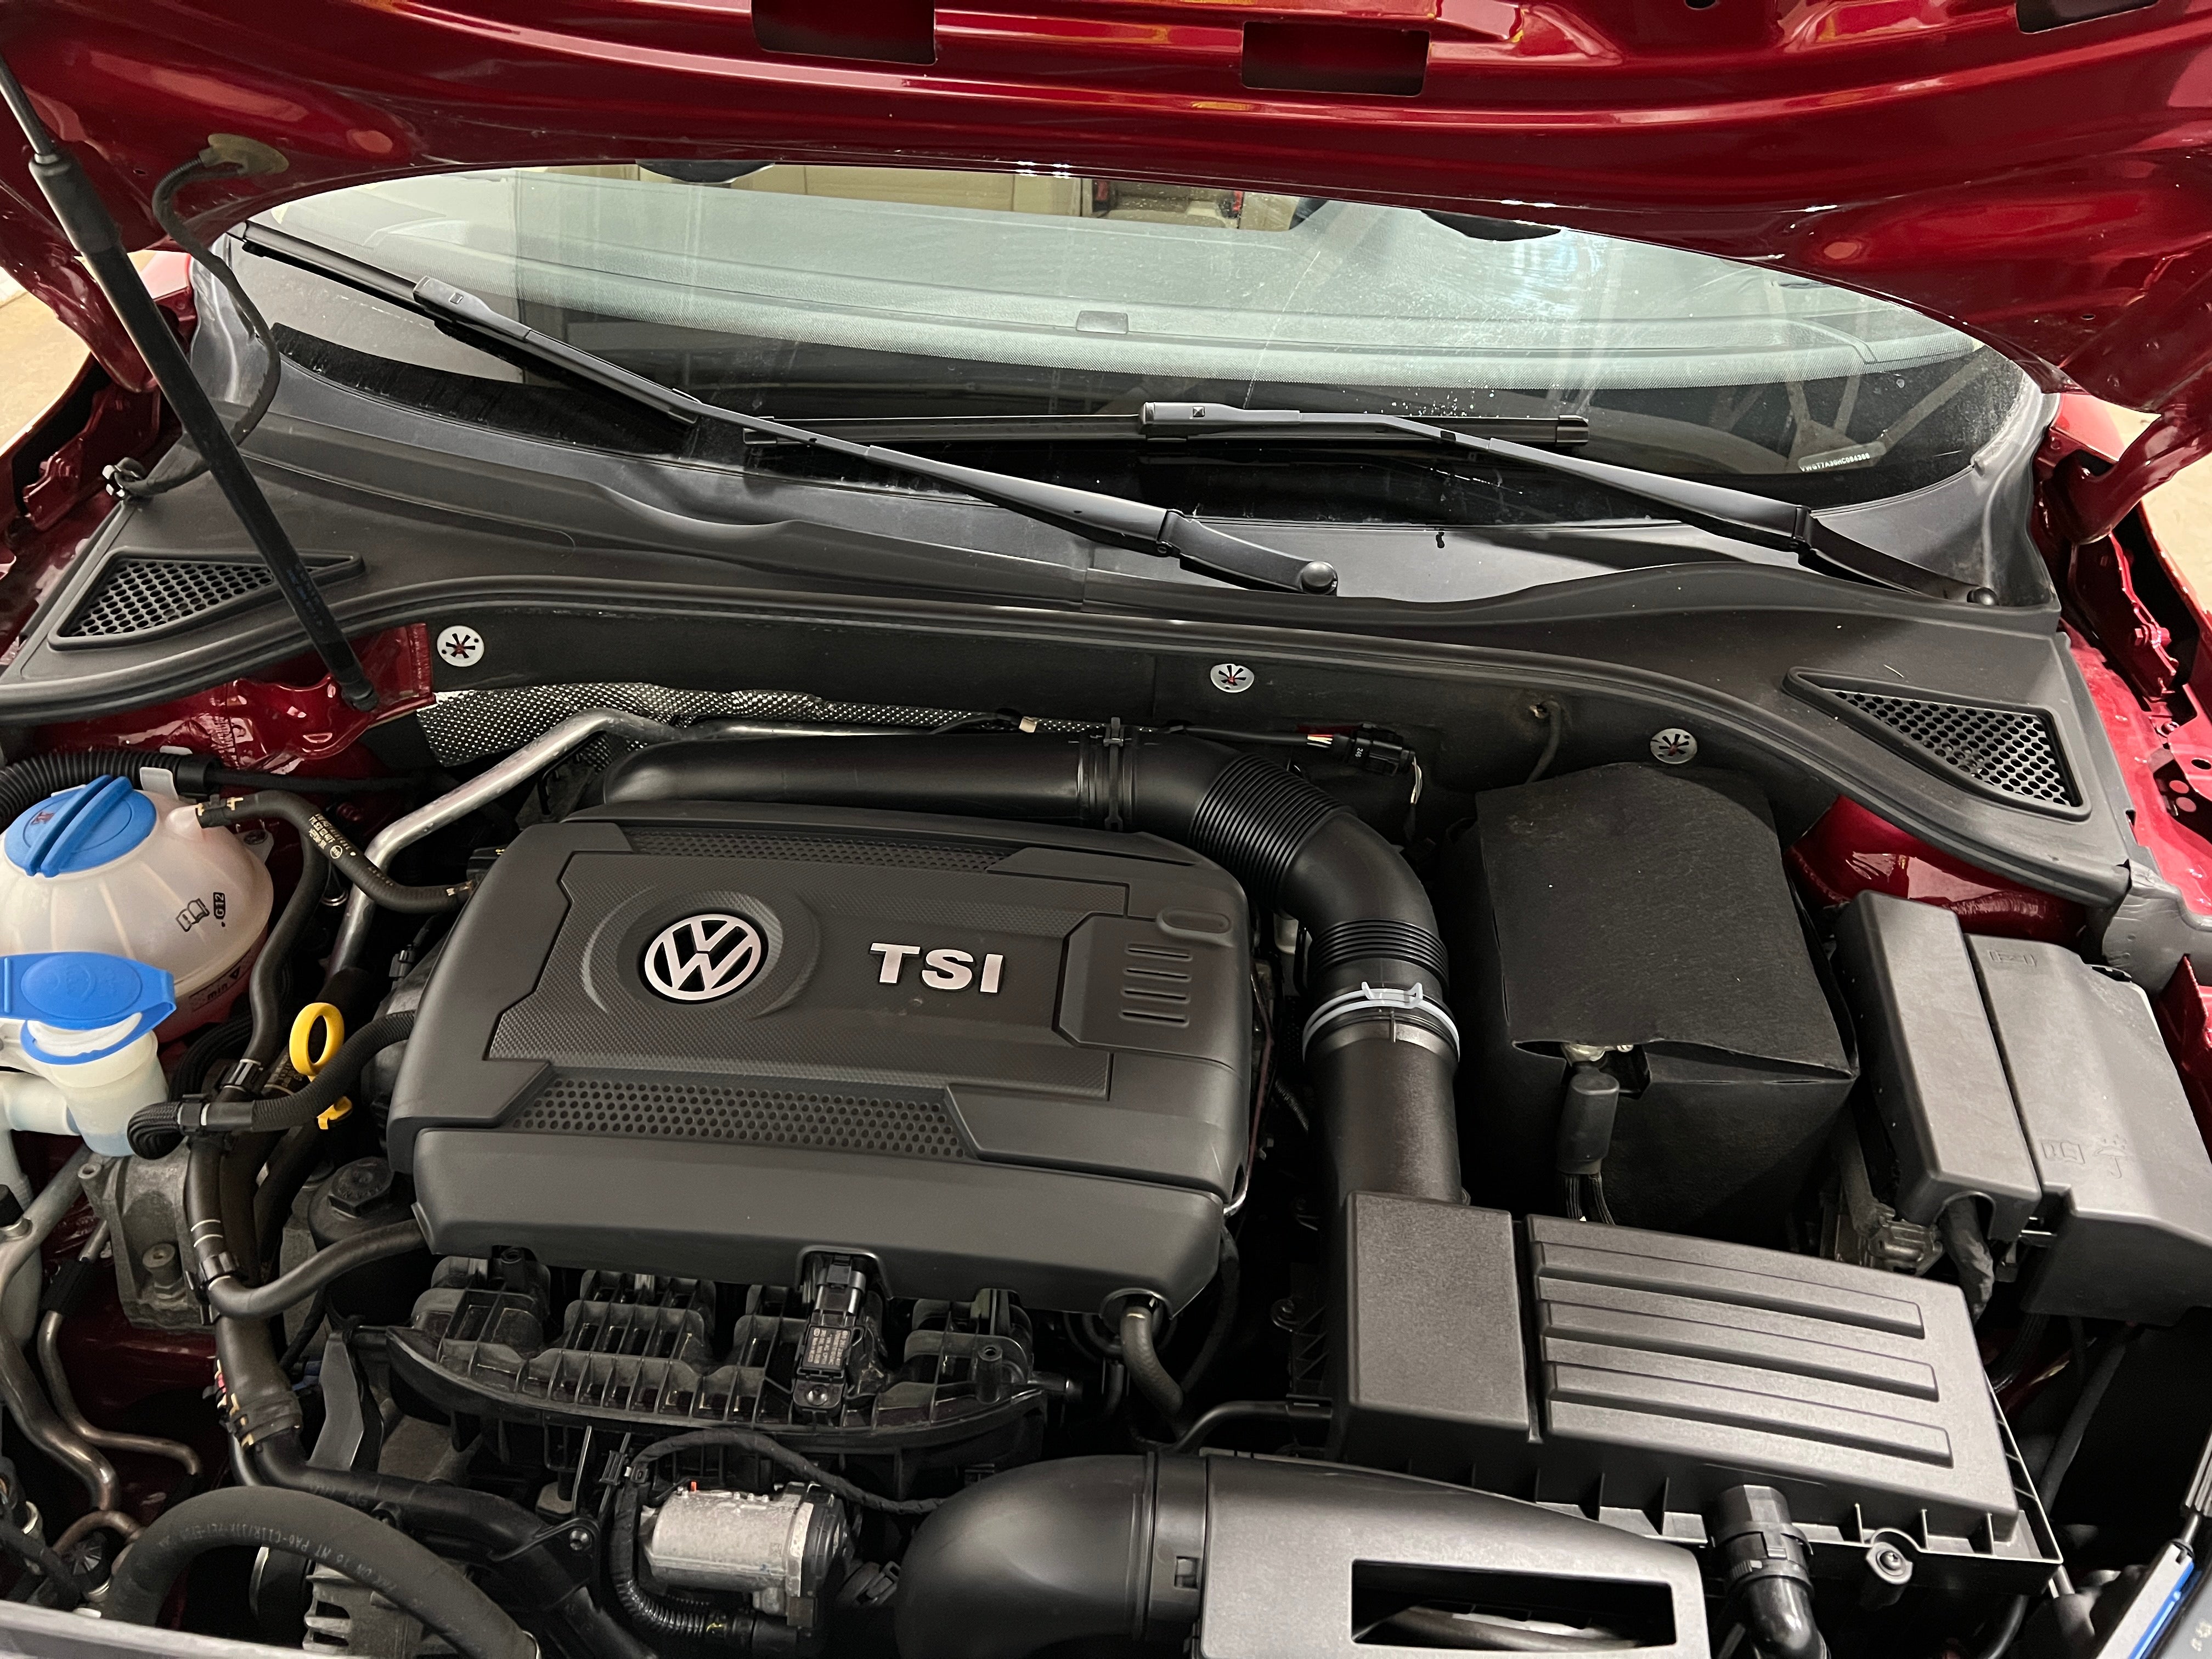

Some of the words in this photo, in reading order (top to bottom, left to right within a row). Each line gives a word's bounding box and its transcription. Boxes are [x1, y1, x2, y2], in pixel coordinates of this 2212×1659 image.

[645, 913, 761, 1001] VW
[870, 942, 1003, 994] TSI
[207, 983, 228, 1000] min
